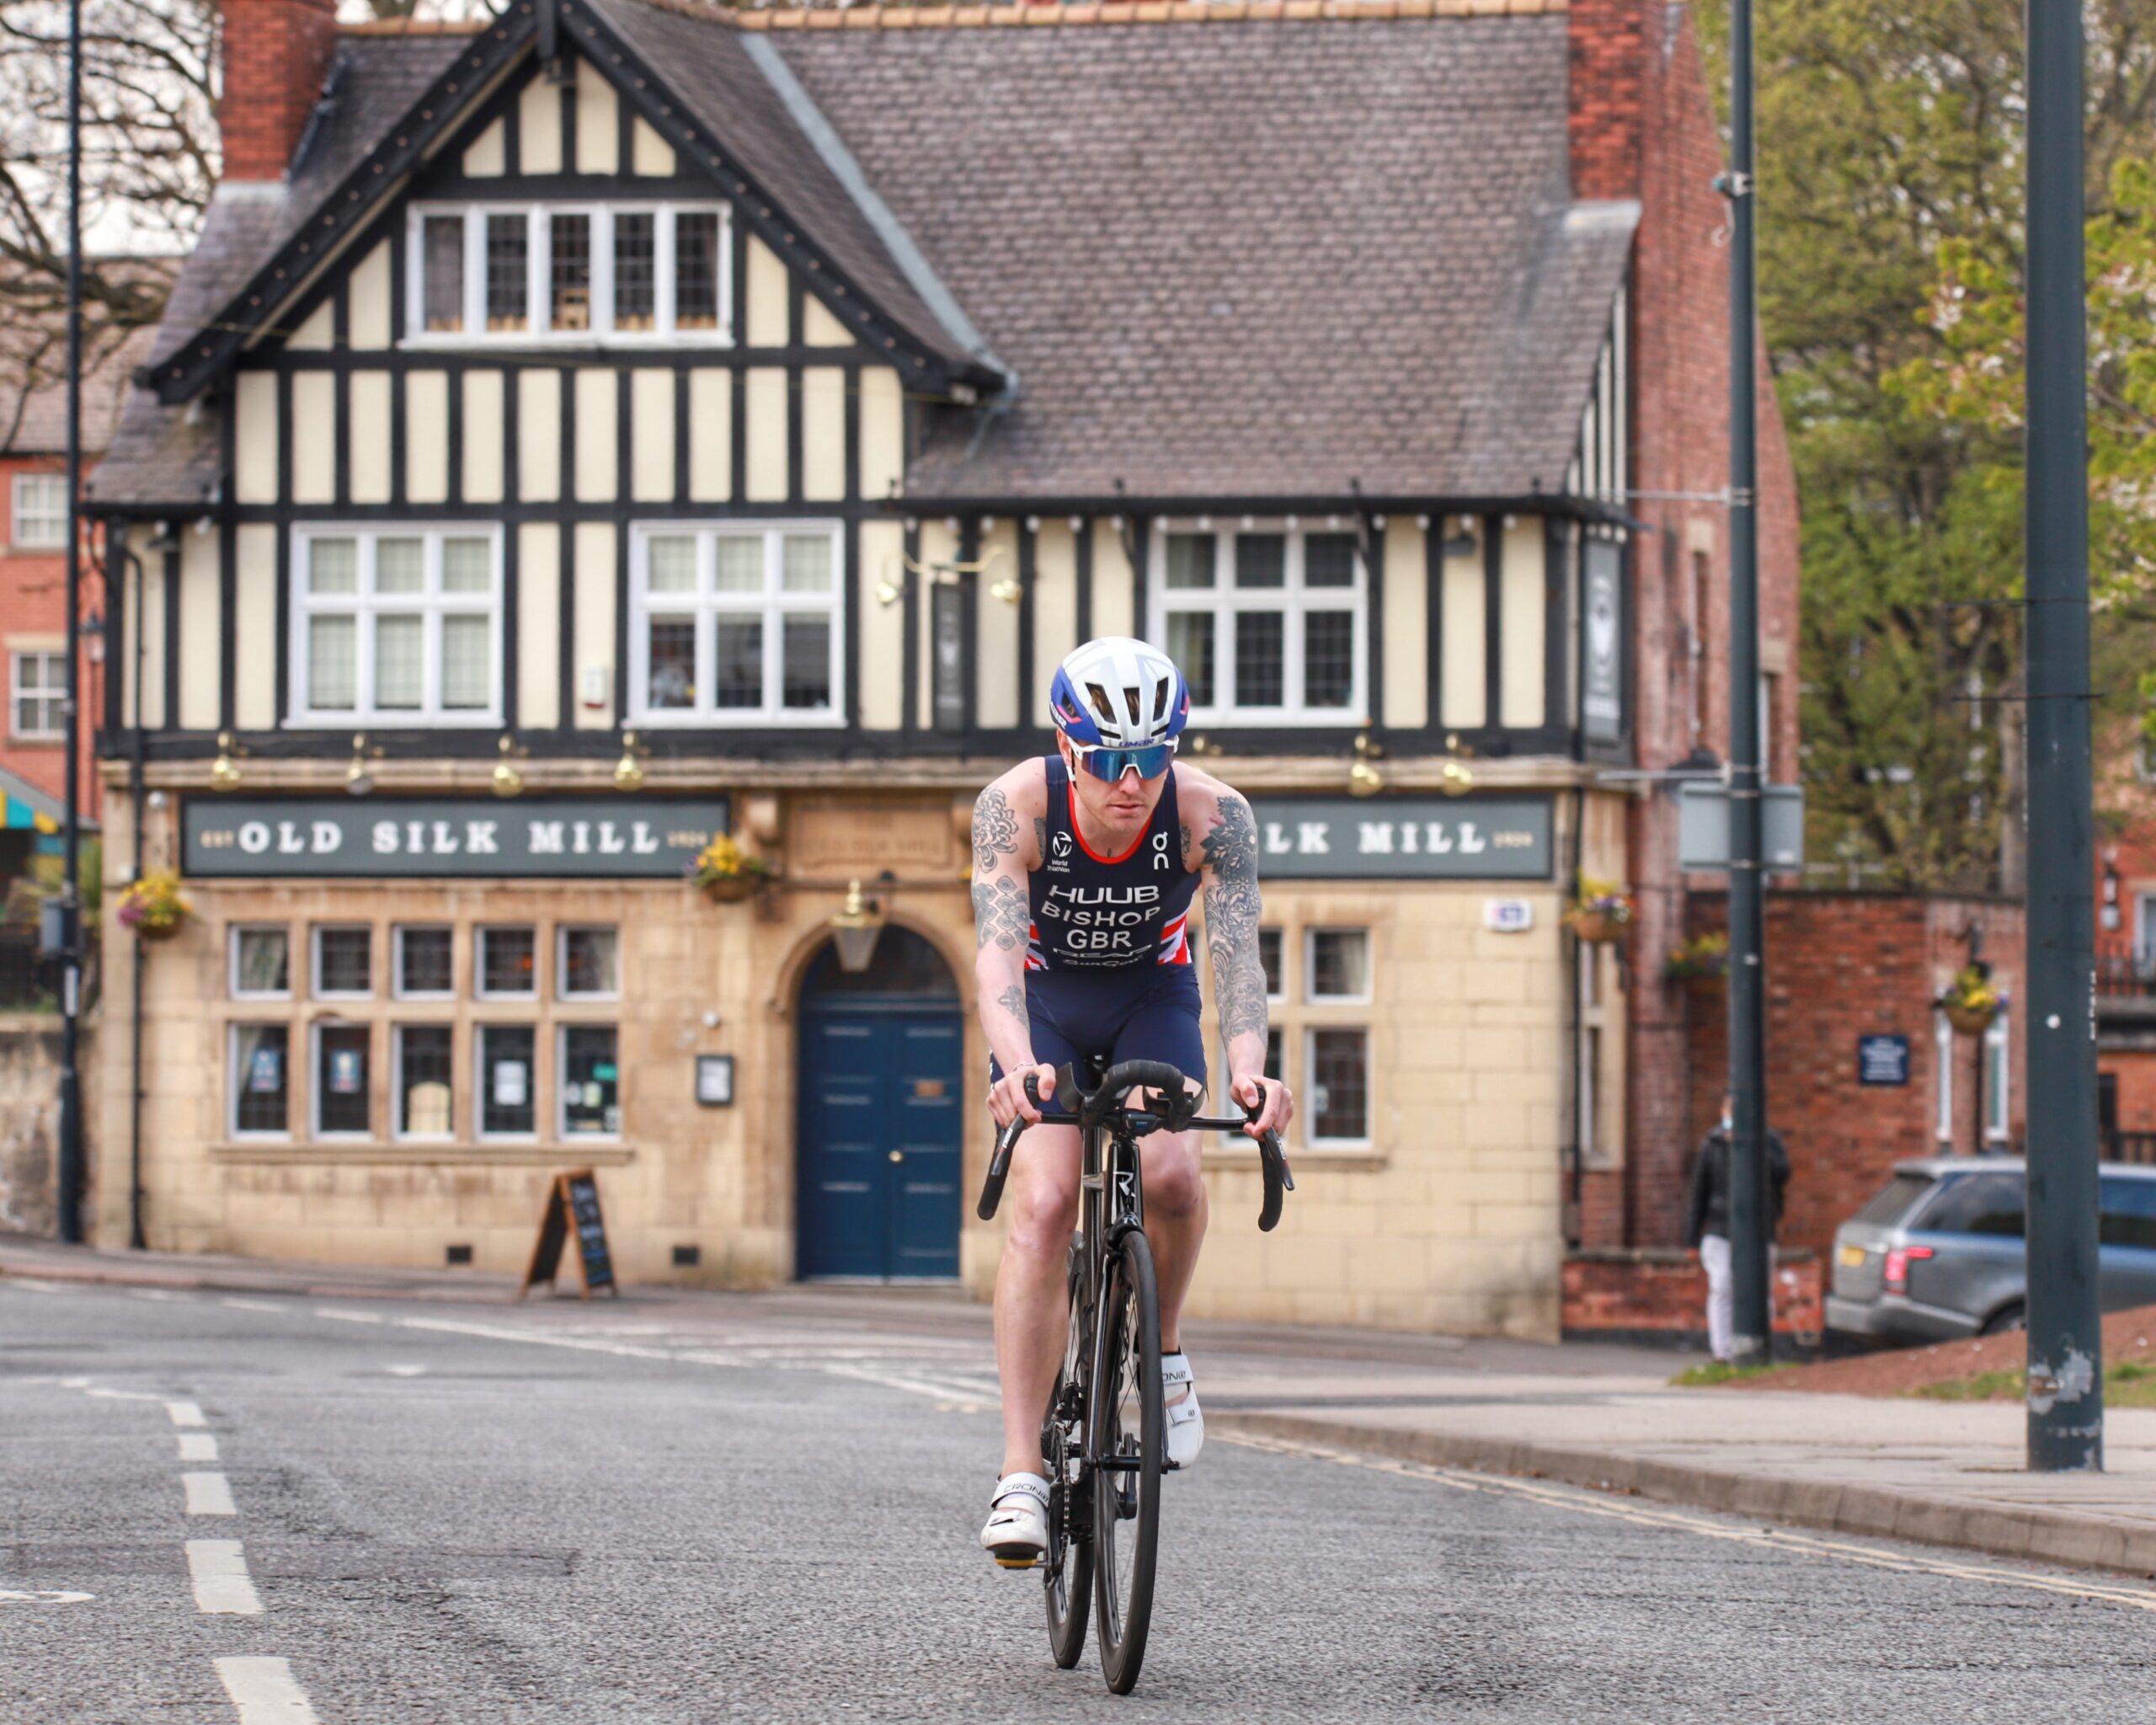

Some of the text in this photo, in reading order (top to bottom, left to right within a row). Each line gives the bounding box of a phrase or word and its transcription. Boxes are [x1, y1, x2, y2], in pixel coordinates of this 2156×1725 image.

[238, 821, 343, 854] OLD
[371, 820, 499, 854] SILK
[527, 821, 659, 854] MILL
[1265, 822, 1331, 854] LK
[1358, 822, 1486, 854] MILL
[1049, 884, 1160, 904] HUUB
[1041, 900, 1161, 927] BISHOP
[1066, 929, 1133, 949] GBR
